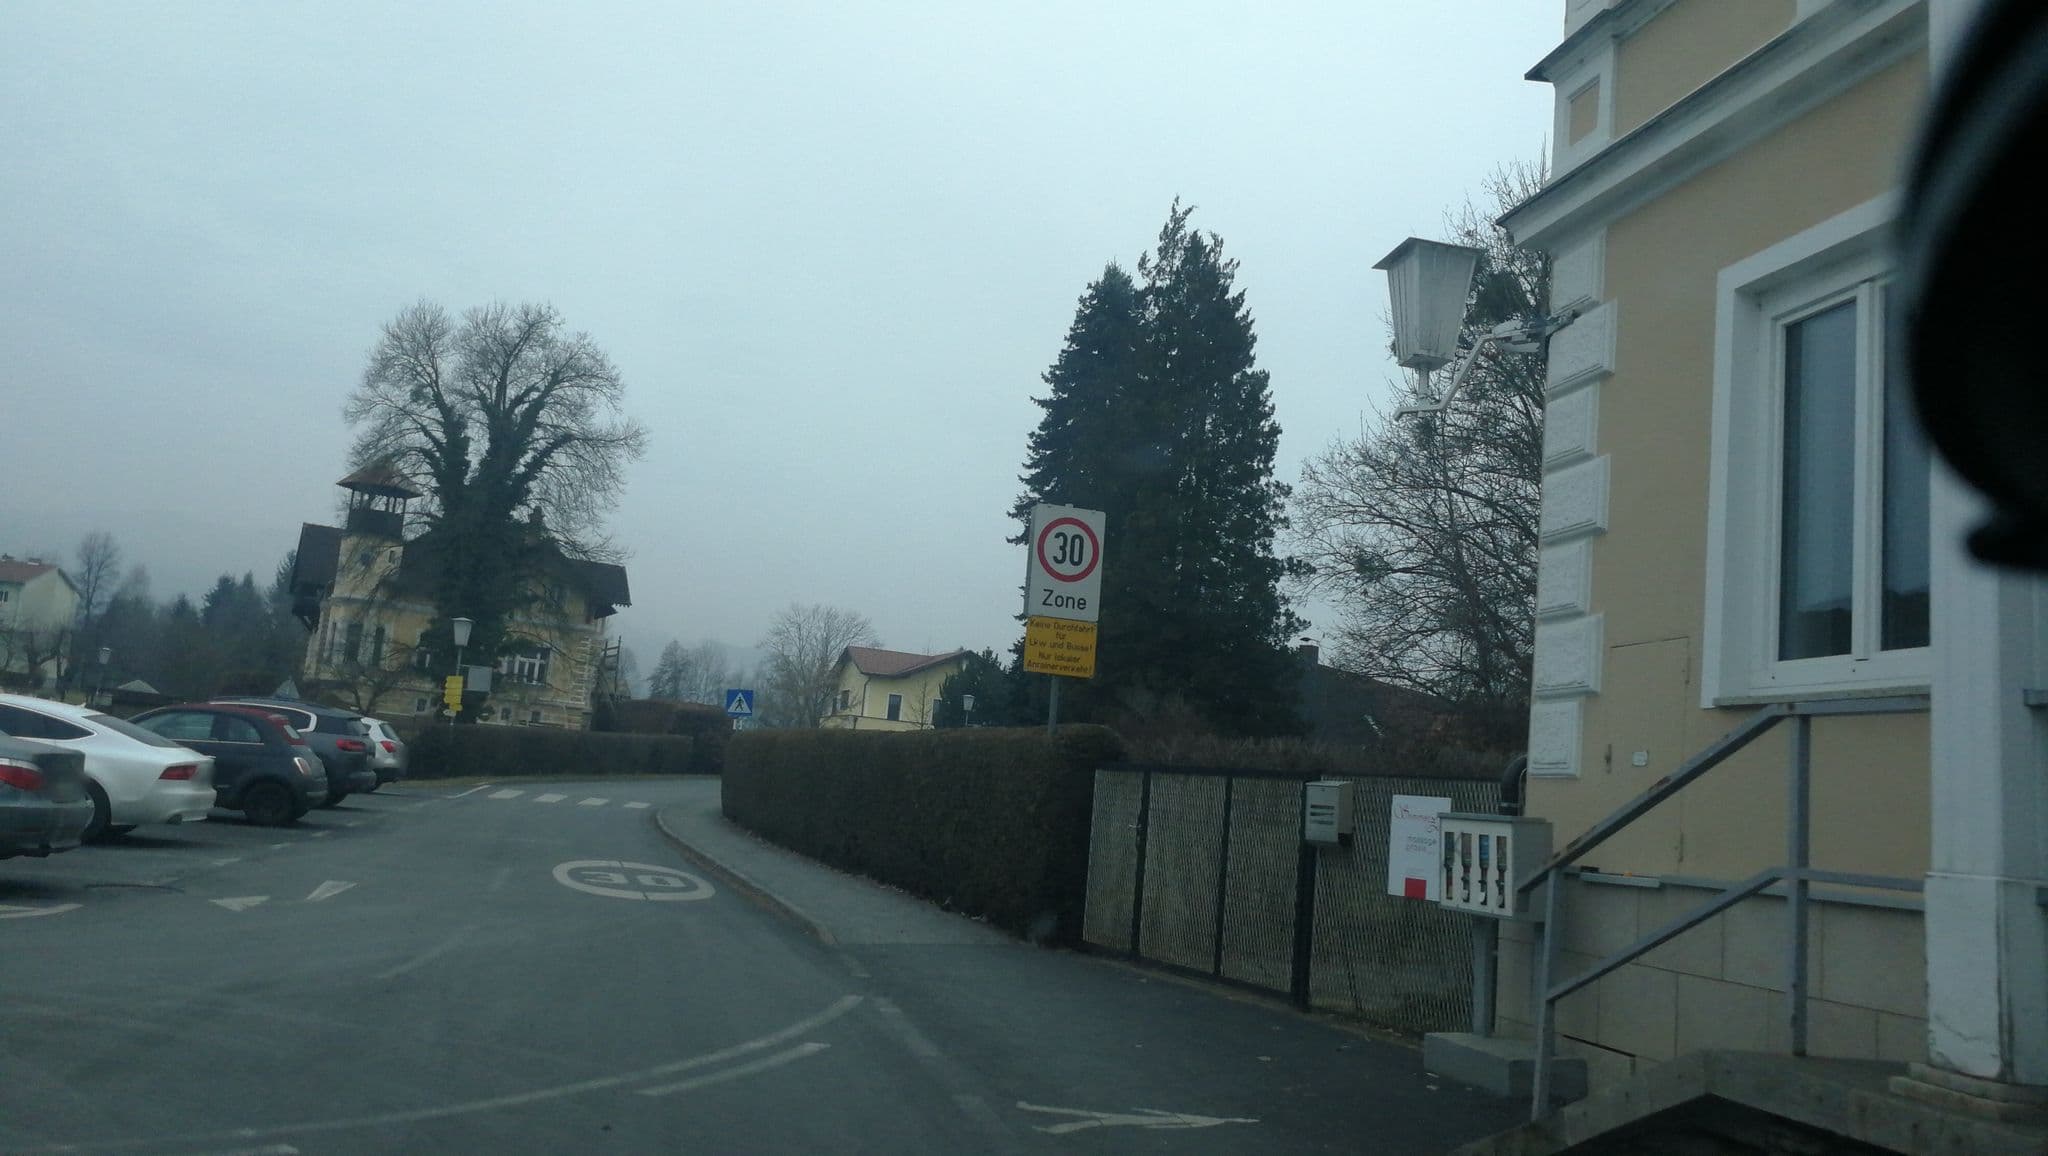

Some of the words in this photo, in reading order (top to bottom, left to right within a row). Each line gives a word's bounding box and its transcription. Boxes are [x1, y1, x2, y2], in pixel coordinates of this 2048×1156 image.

[1053, 532, 1084, 566] 30
[1042, 589, 1087, 610] Zone
[581, 871, 686, 887] 30
